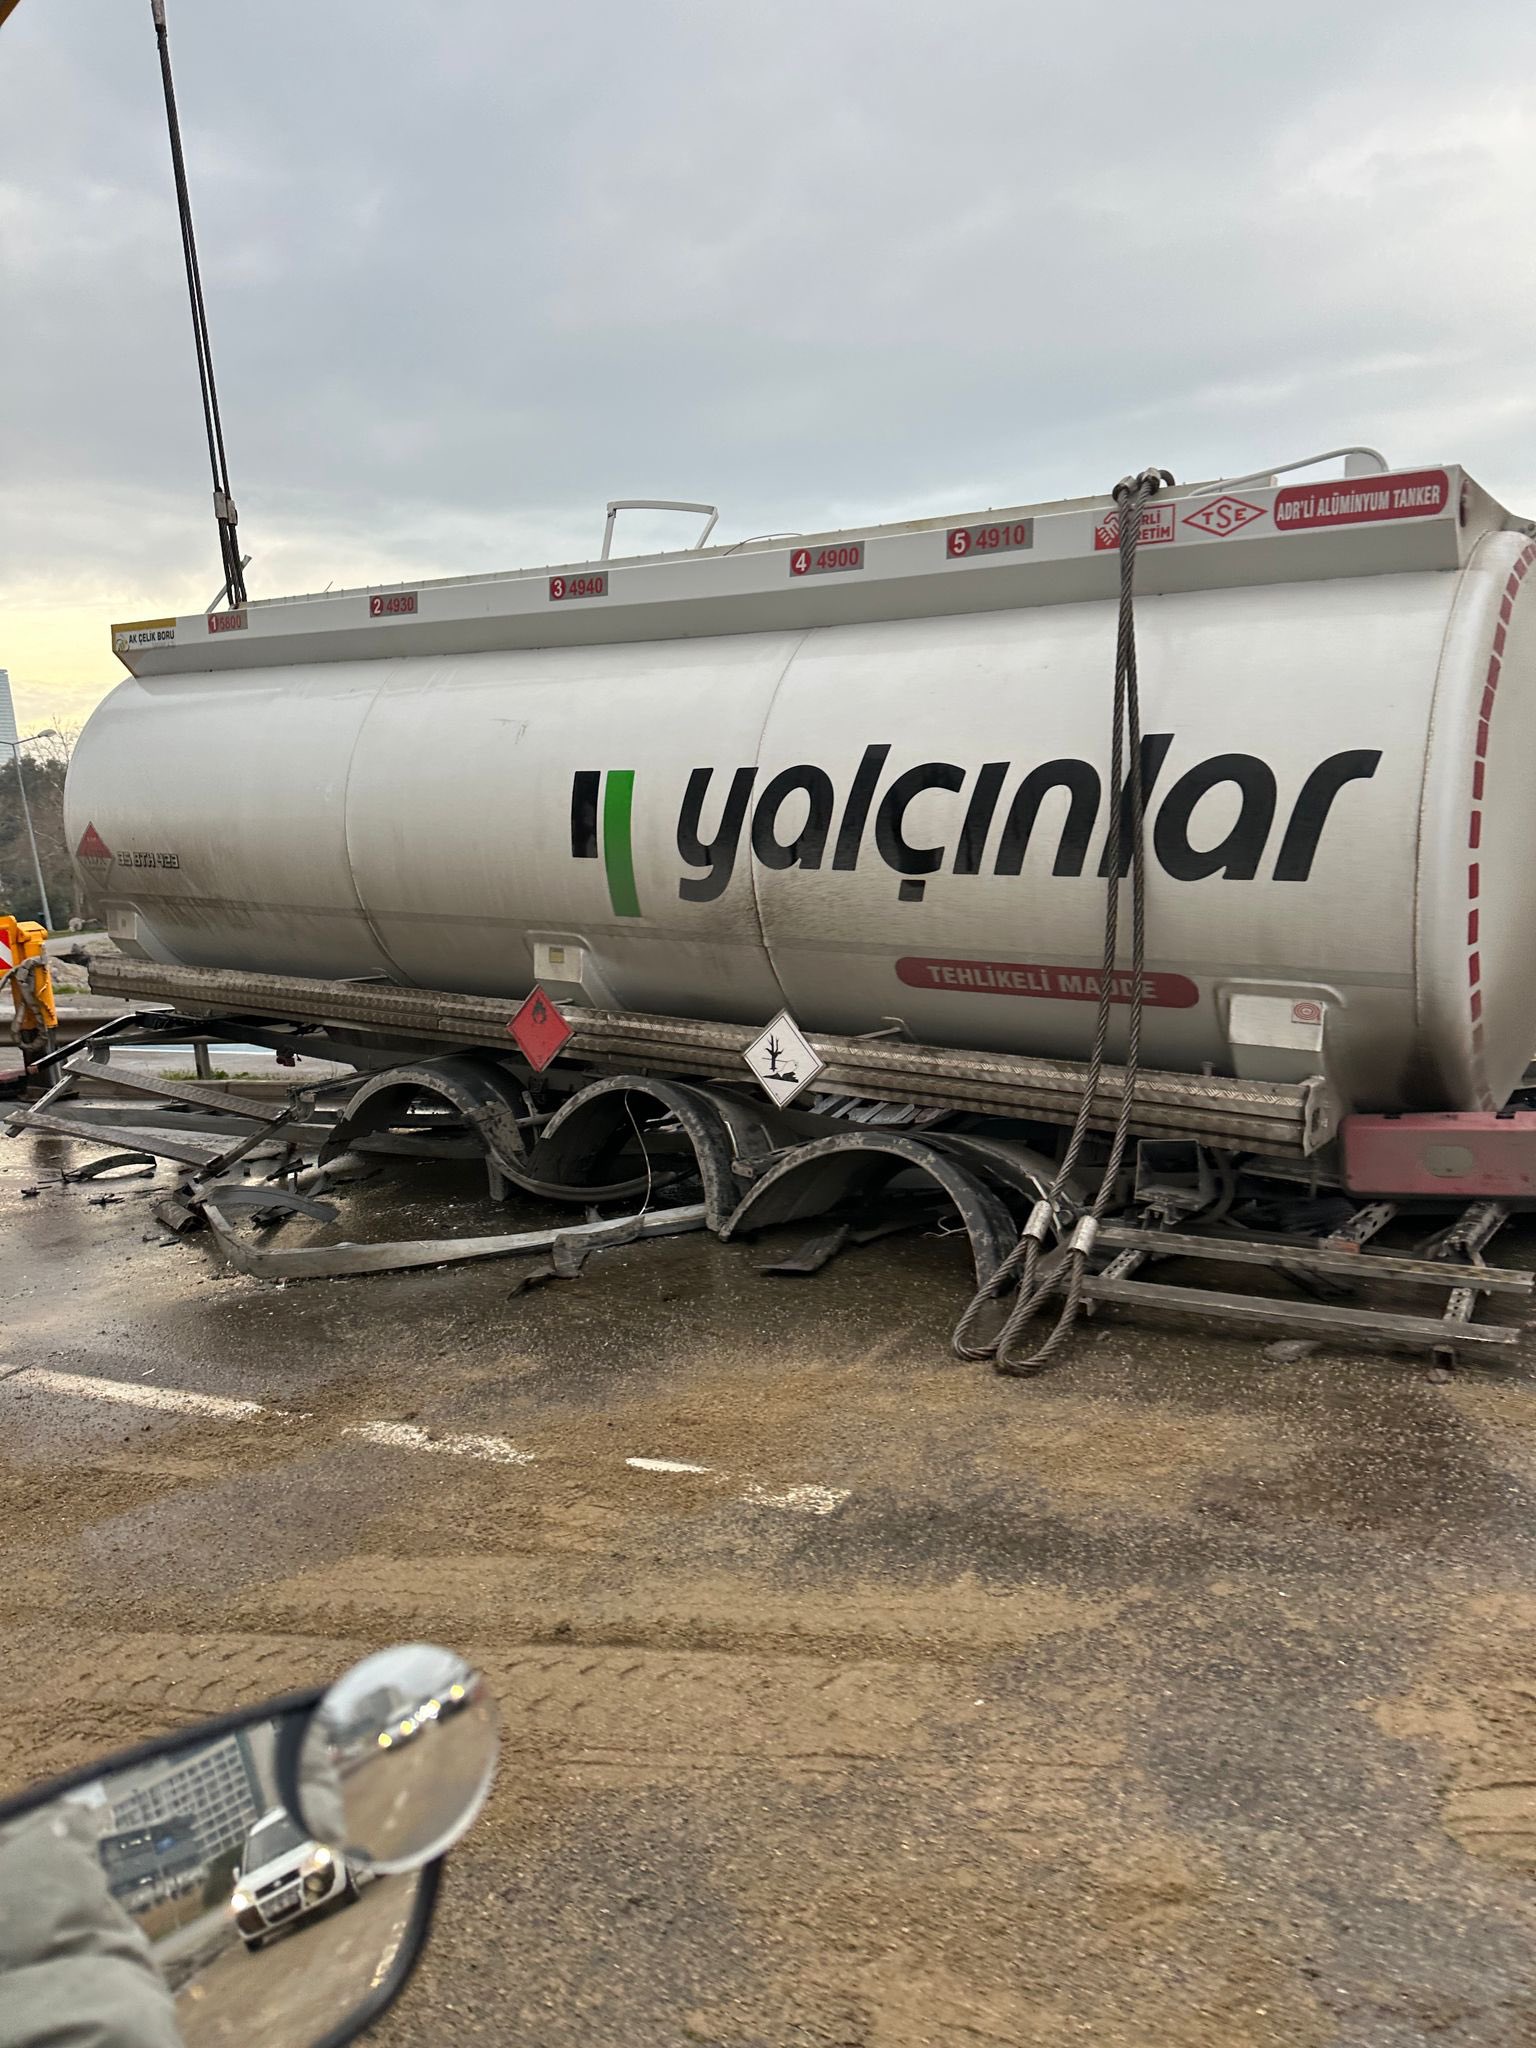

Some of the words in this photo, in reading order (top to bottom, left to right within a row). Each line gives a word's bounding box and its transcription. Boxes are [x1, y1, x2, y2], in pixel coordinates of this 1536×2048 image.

[1277, 495, 1315, 521] ADR'Lİ
[1317, 489, 1390, 517] ALÜMİNYUM
[1393, 485, 1441, 509] TANKER
[1202, 504, 1247, 529] TSE
[953, 532, 966, 553] 5
[975, 525, 1025, 549] 4910
[795, 552, 807, 572] 4
[816, 547, 860, 569] 4900
[554, 578, 563, 598] 3
[569, 577, 603, 596] 4940
[373, 598, 381, 614] 2
[386, 596, 415, 612] 4930
[211, 615, 217, 630] 1
[128, 633, 138, 644] AK
[138, 630, 156, 645] ÇELİK
[158, 630, 175, 641] BORU
[676, 733, 1383, 902] yalçınlar
[926, 964, 1051, 992] TEHLİKELİ
